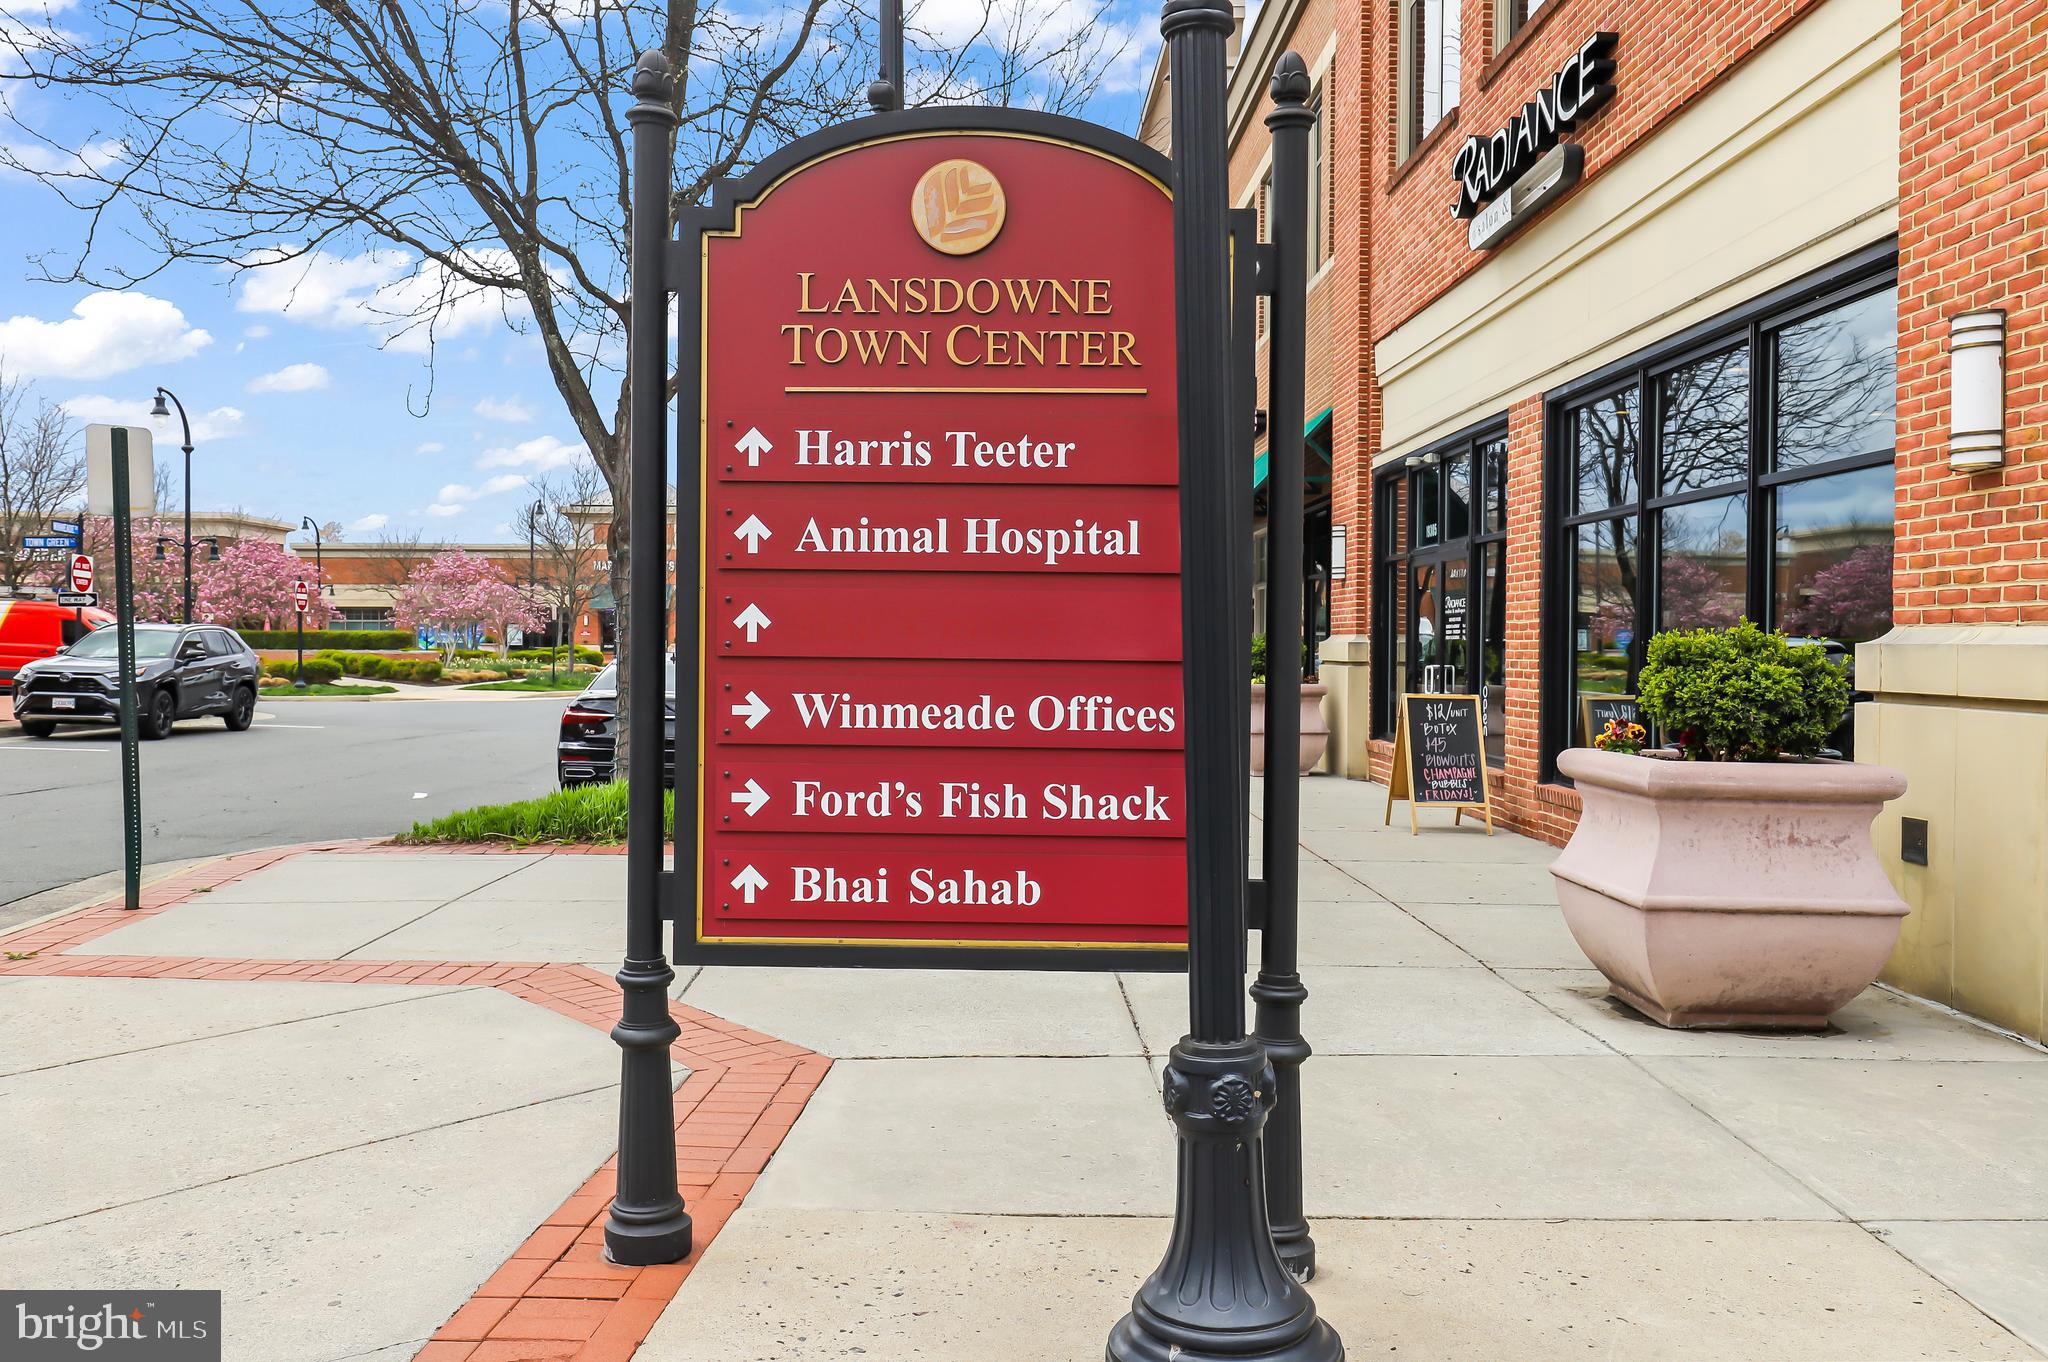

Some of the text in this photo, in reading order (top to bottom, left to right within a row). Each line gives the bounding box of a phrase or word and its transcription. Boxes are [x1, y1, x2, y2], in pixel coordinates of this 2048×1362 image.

[1450, 32, 1614, 219] RADIANCE
[1477, 210, 1499, 235] salon
[797, 273, 1113, 314] LANSDOWNE
[781, 325, 1142, 366] TOWN CENTER
[795, 430, 1076, 468] Harris Teeter
[25, 537, 44, 547] TOWN
[46, 537, 70, 547] GREEN
[795, 517, 1141, 565] Animal Hospital
[792, 693, 1176, 733] Winmeade Offices
[1423, 722, 1457, 736] BOTOX
[1423, 767, 1477, 781] CHAMPAGNE
[792, 781, 1171, 821] Ford's Fish Shack
[791, 867, 1041, 906] Bhai Sahab
